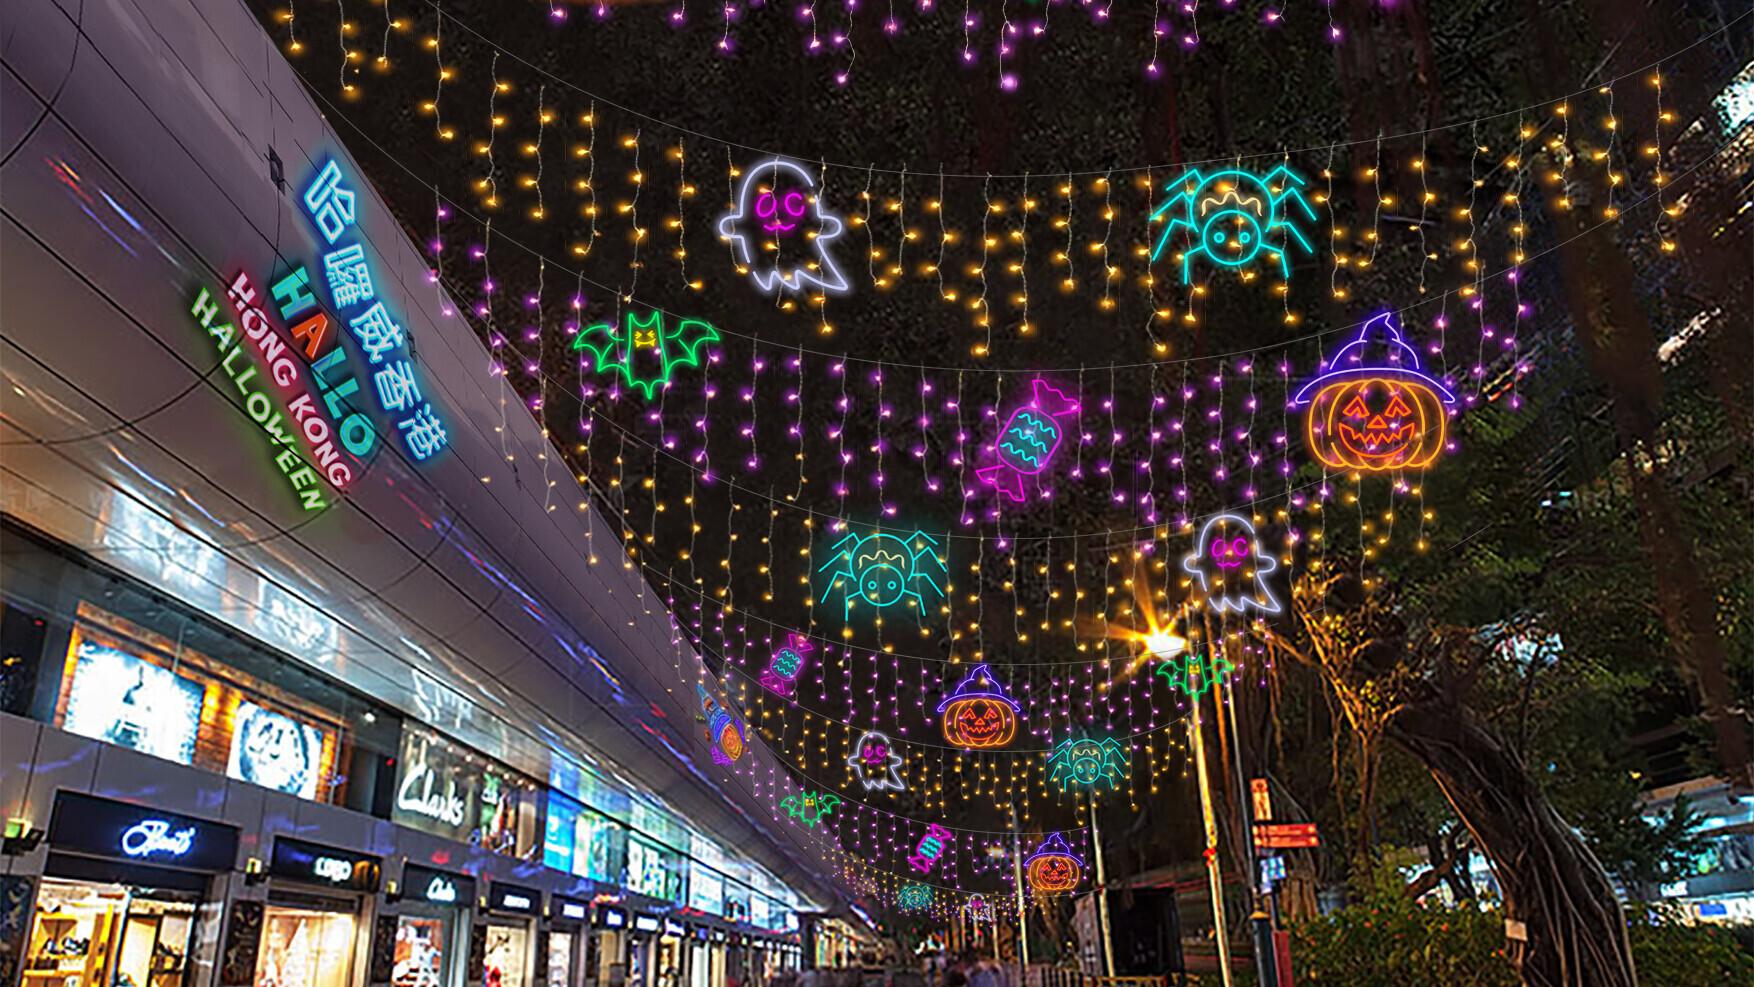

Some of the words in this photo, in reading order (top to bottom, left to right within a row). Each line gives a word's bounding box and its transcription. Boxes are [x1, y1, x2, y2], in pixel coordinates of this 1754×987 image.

[191, 288, 327, 511] HALLOWEEN
[228, 272, 297, 388] HONG
[288, 394, 350, 487] KONG
[271, 266, 376, 456] HALLO
[304, 160, 447, 460] 哈囉威香港
